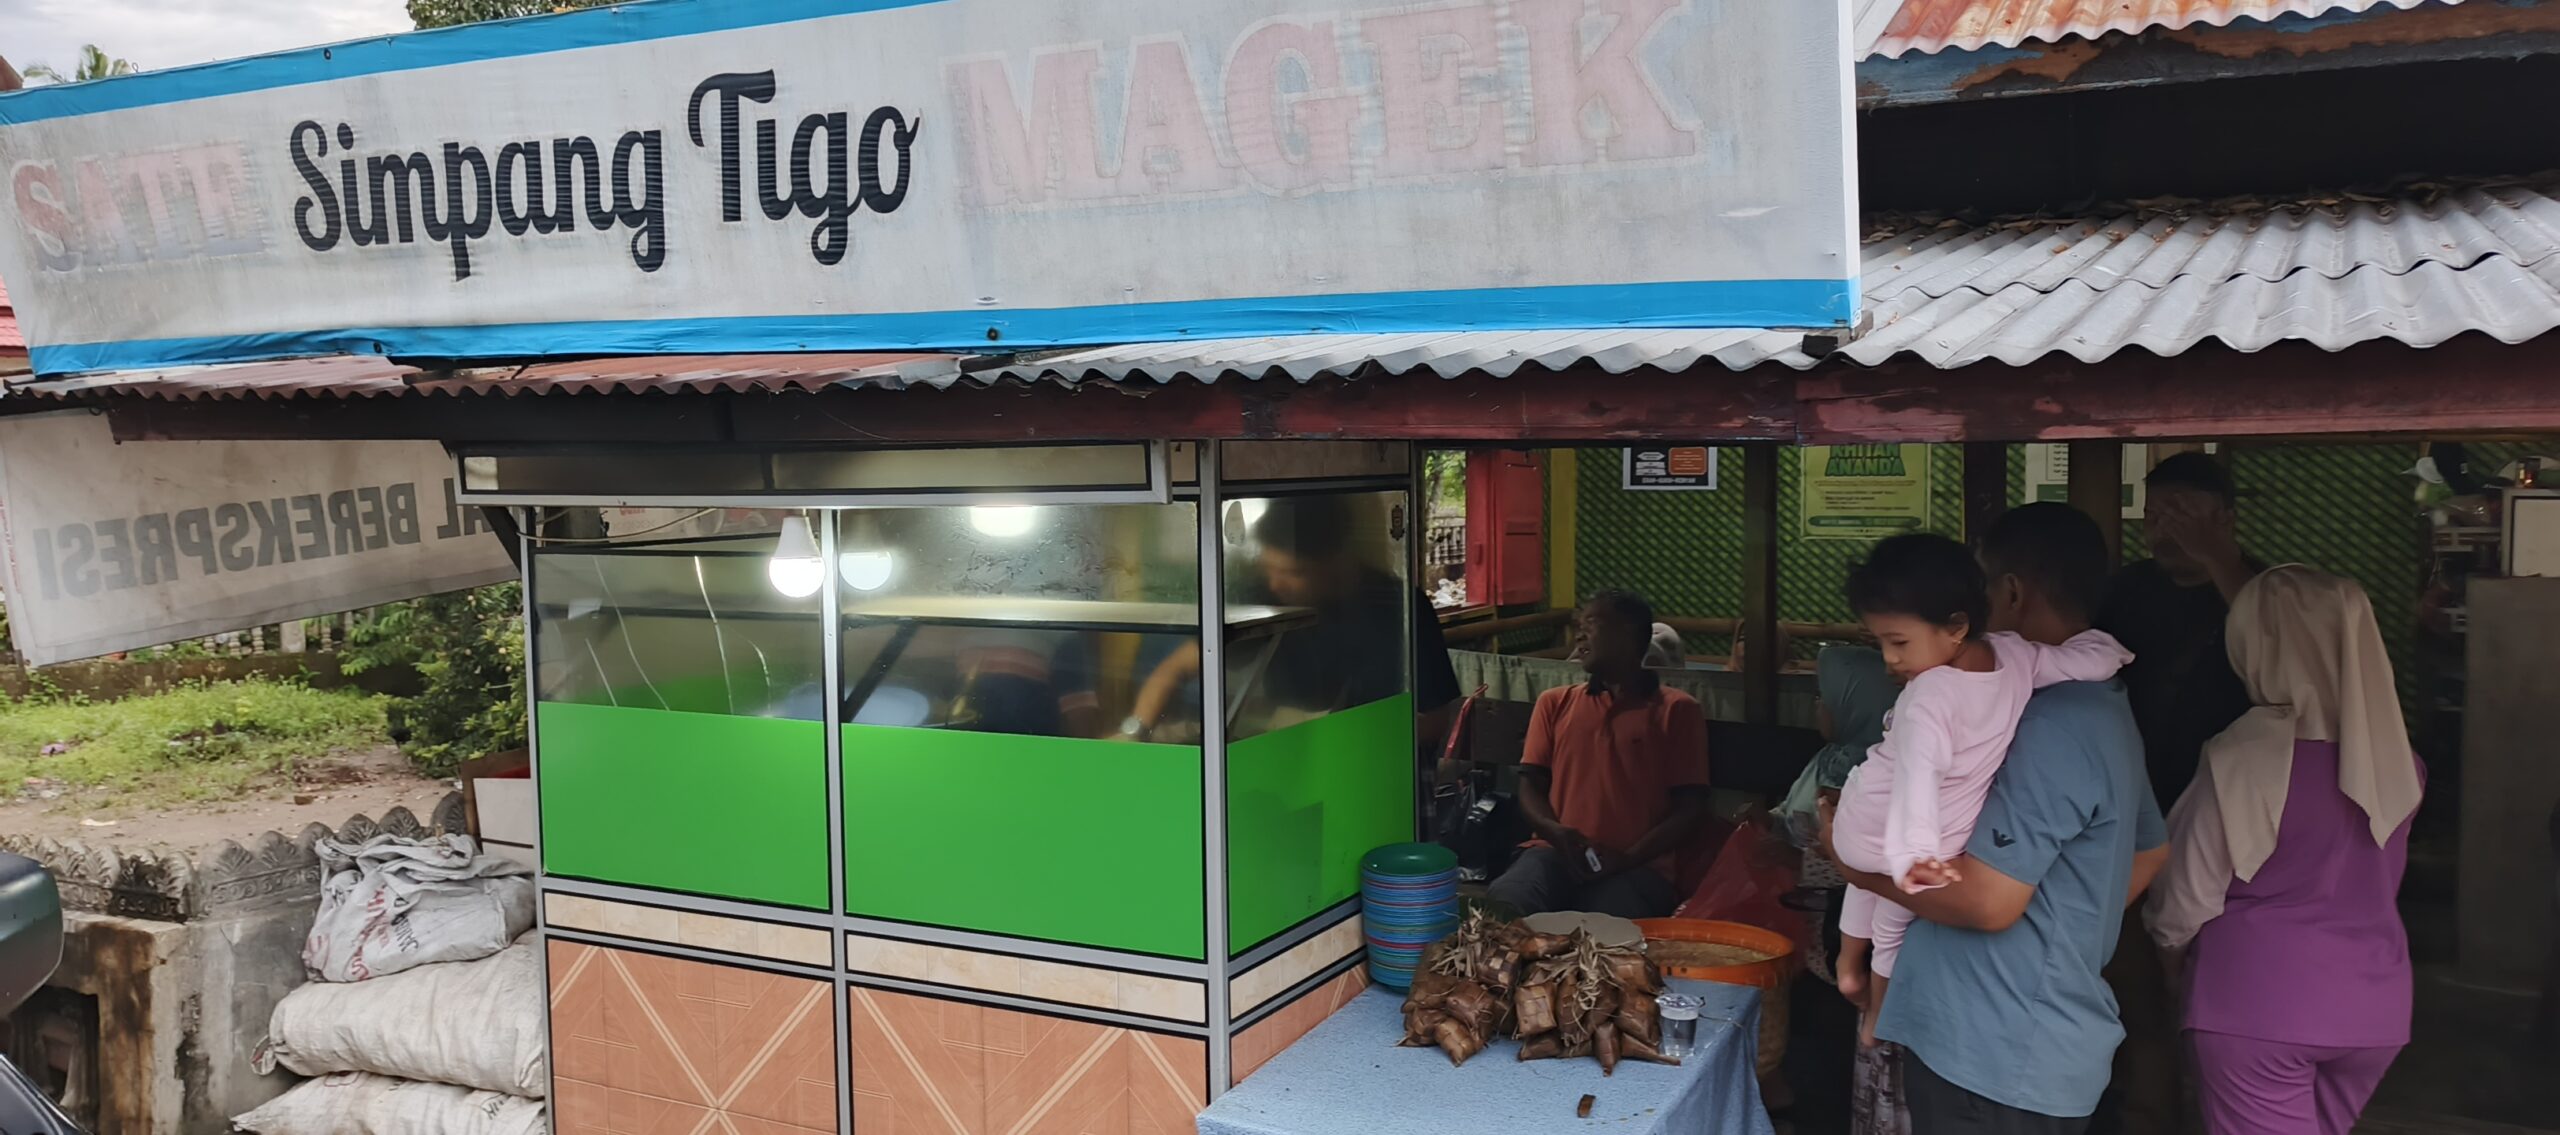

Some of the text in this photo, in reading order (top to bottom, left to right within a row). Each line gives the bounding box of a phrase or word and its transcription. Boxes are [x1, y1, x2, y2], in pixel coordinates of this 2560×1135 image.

[290, 120, 665, 281] Simpang
[689, 69, 920, 265] Tigo
[945, 0, 1702, 203] MAGEK
[1824, 456, 1906, 476] ANANDA
